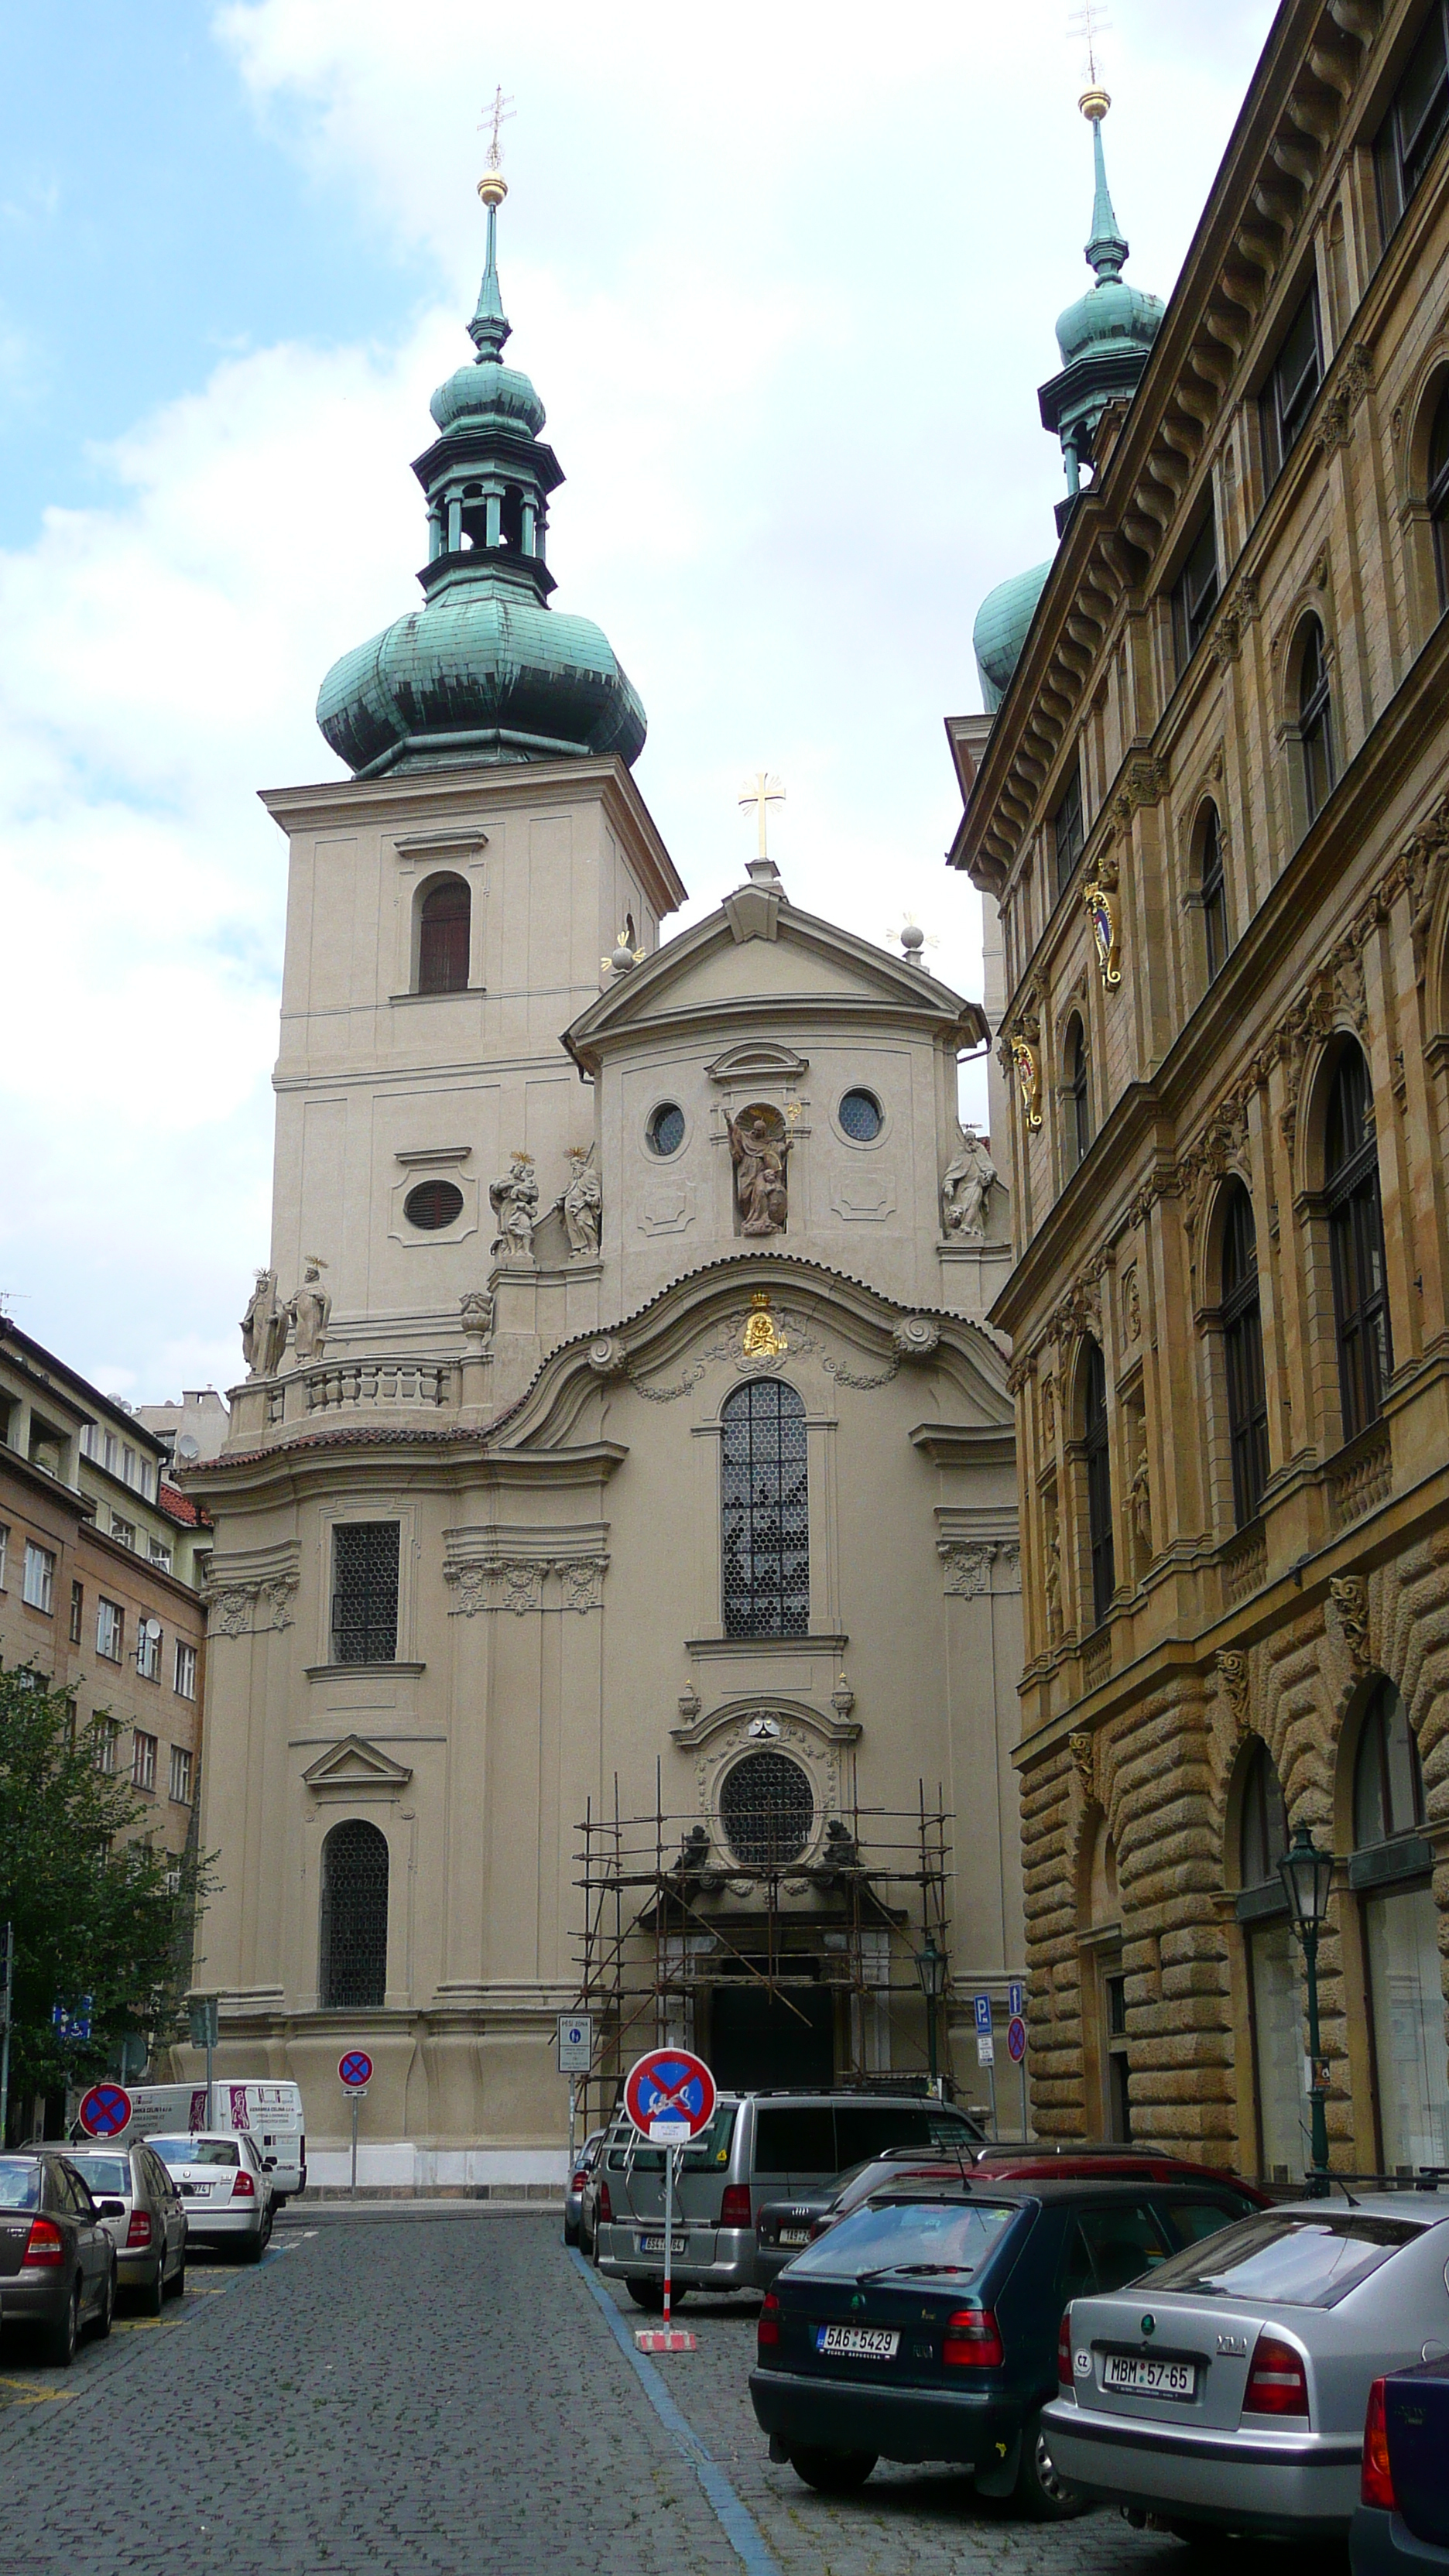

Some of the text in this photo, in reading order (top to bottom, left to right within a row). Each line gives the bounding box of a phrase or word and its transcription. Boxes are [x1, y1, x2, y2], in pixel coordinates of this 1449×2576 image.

[977, 1999, 986, 2023] P
[827, 2328, 892, 2352] 5A6 5429
[1077, 2355, 1088, 2368] CZ
[1111, 2358, 1188, 2389] MBM 57-65
